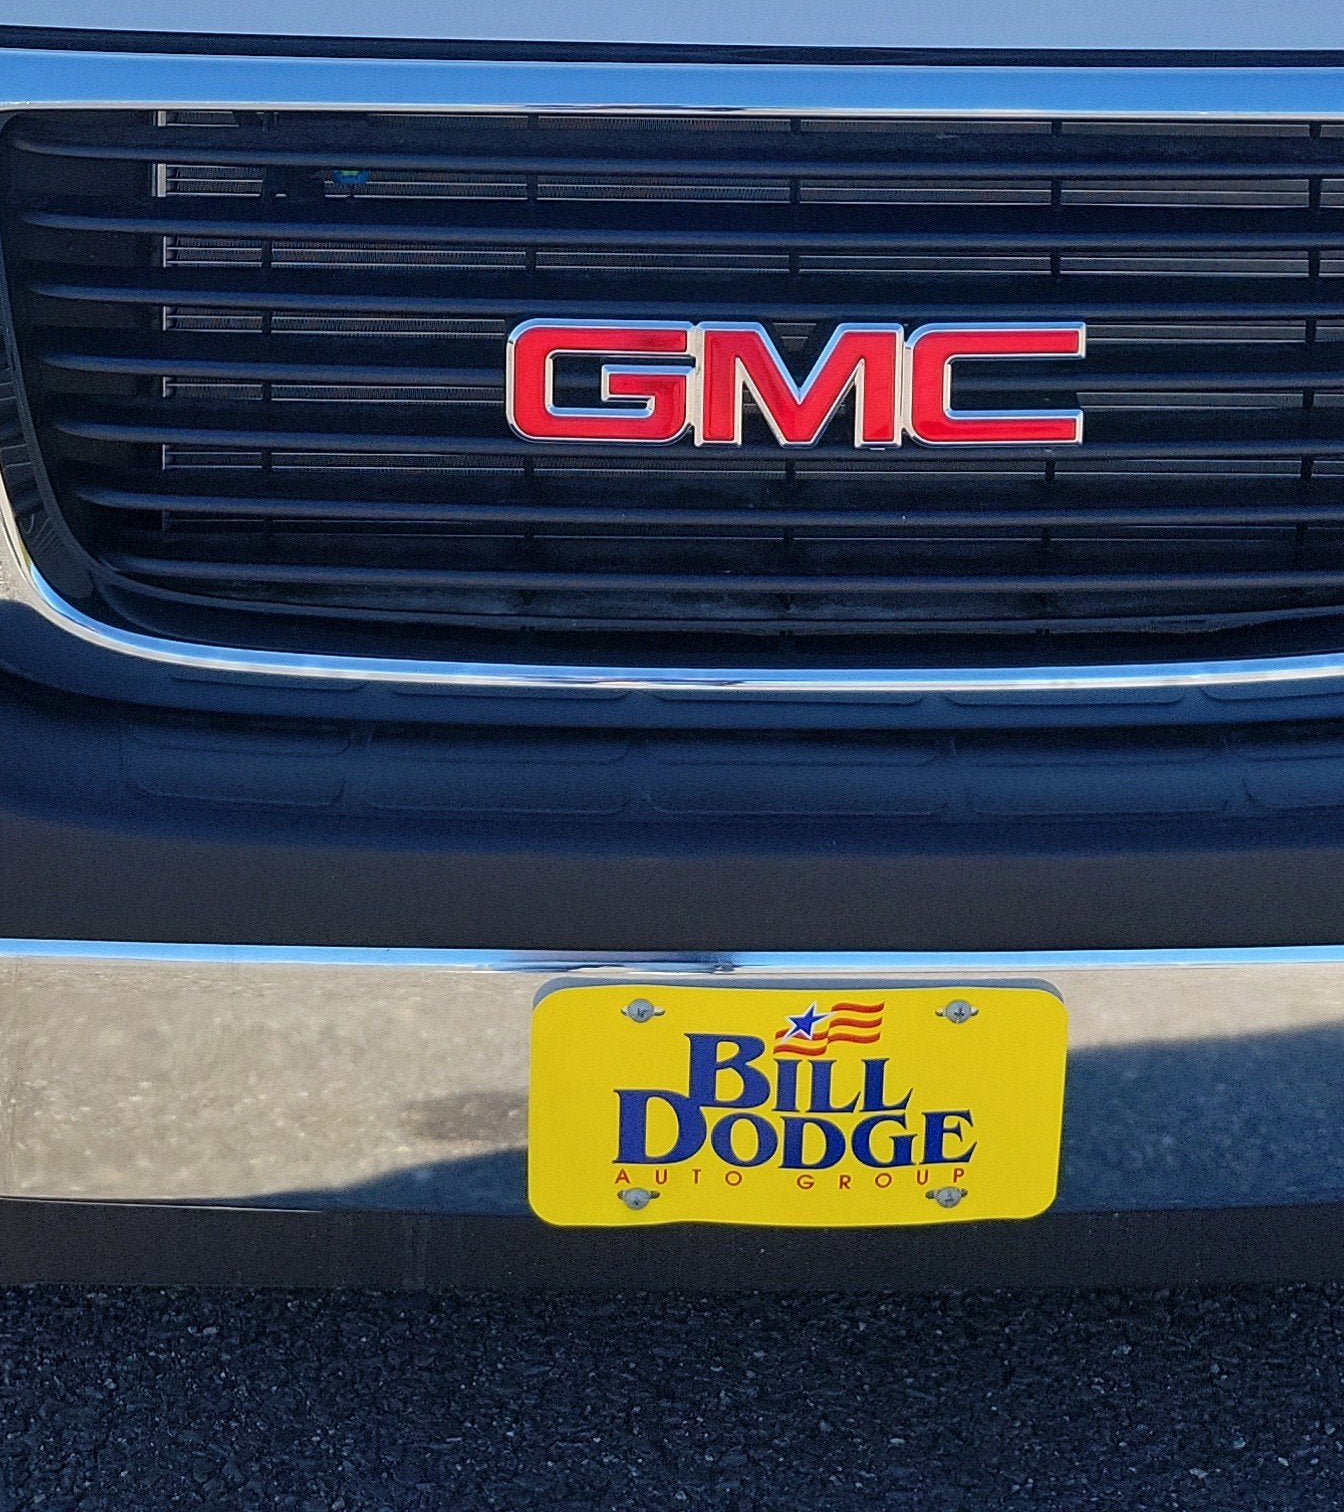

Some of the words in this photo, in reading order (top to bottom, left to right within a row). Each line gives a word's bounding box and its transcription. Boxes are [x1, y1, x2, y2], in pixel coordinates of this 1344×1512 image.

[506, 318, 1087, 447] GMC
[684, 1033, 913, 1113] BILL
[612, 1088, 977, 1170] DODGE
[614, 1168, 743, 1187] AUTO
[796, 1168, 965, 1190] GROUP
